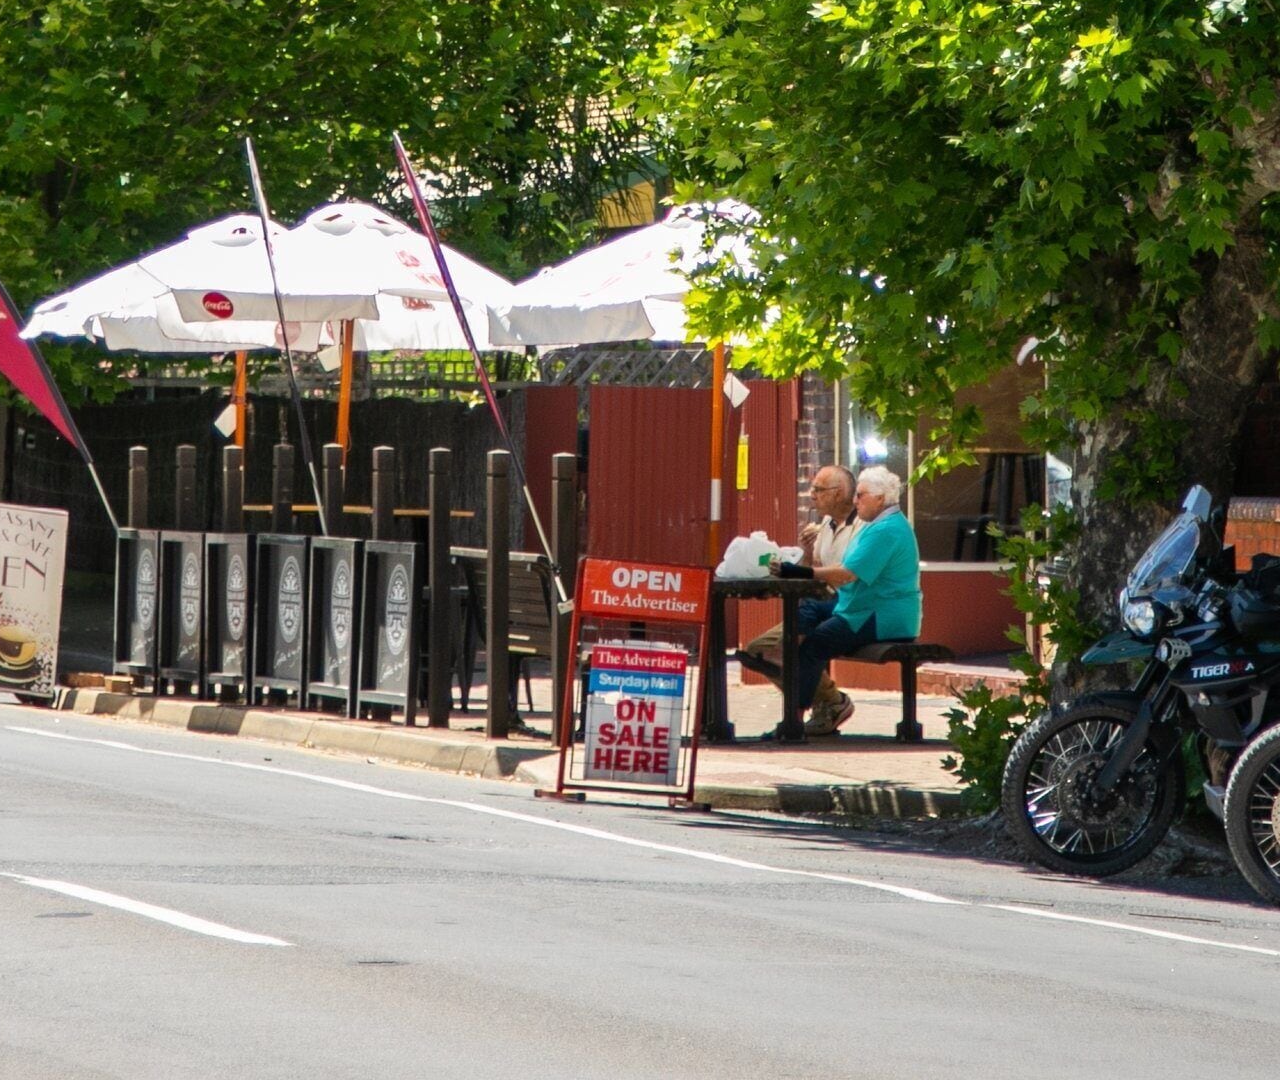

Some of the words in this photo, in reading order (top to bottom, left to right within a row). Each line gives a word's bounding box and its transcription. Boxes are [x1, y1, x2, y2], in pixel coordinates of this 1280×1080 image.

[612, 567, 682, 592] OPEN
[591, 589, 620, 607] The
[620, 593, 698, 614] Advertiser
[597, 651, 621, 666] The
[621, 654, 684, 670] Advertiser
[1191, 663, 1230, 678] TIGER
[598, 673, 650, 691] Sunday
[650, 677, 678, 690] Mail
[616, 699, 656, 723] ON
[598, 723, 670, 749] SALE
[593, 748, 670, 774] HERE
